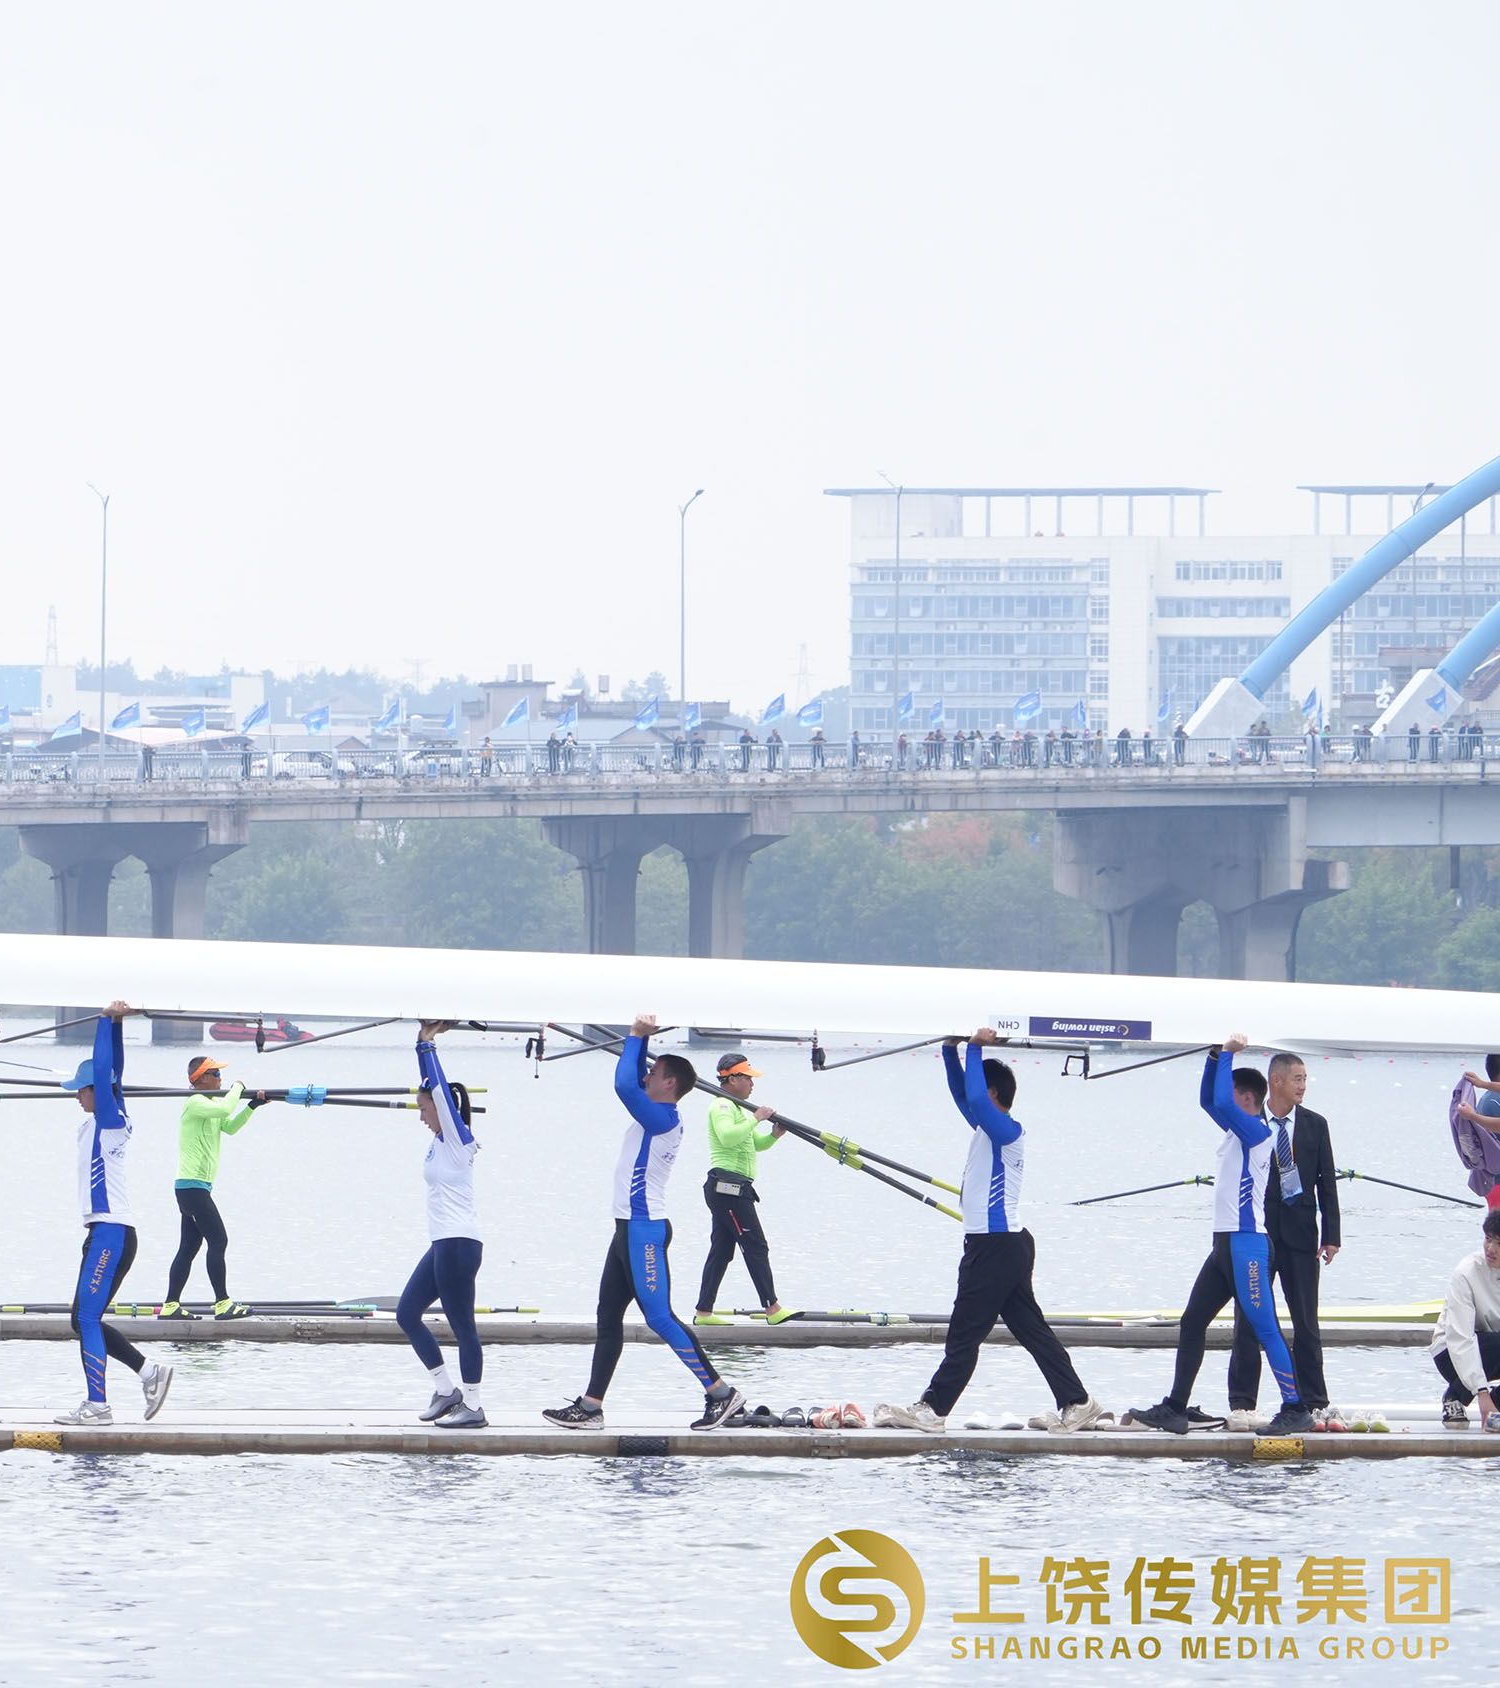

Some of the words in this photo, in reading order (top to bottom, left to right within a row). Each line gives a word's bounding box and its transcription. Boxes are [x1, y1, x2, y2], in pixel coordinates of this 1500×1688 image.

[997, 1020, 1020, 1030] CHN
[1052, 1021, 1088, 1032] rowing
[1088, 1024, 1116, 1033] asian
[644, 1243, 658, 1283] XJTURC
